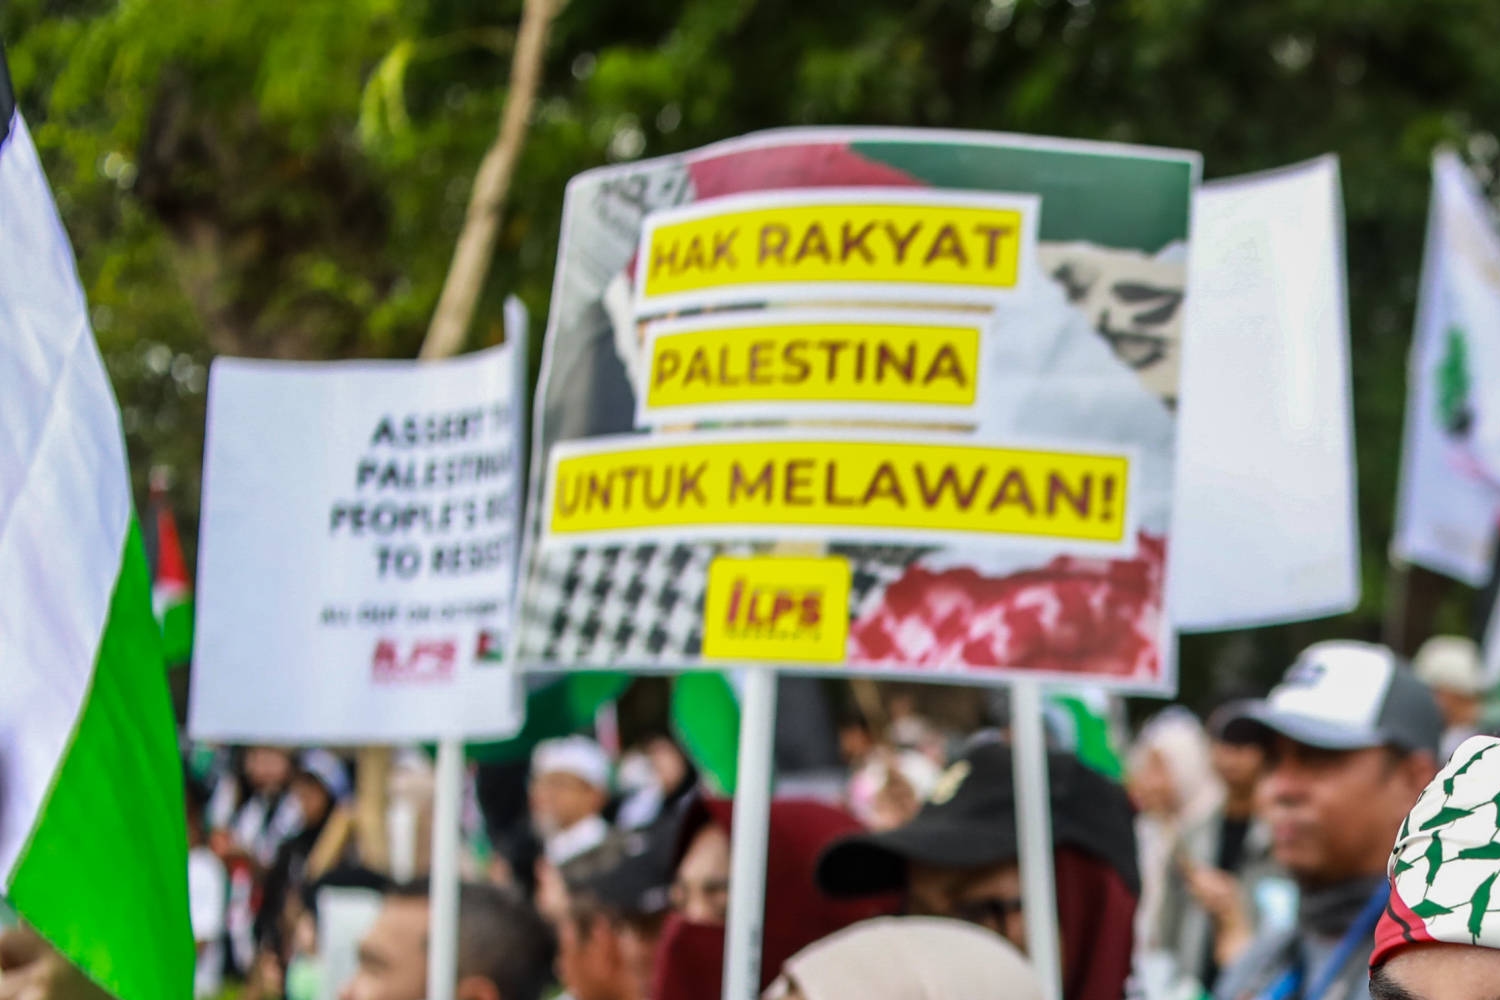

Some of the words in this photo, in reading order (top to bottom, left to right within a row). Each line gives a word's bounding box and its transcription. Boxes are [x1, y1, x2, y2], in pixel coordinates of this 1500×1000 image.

[649, 226, 741, 281] HAK
[754, 219, 1016, 273] RAKYAT
[653, 337, 970, 391] PALESTINA
[355, 449, 514, 490] PALESTIN
[556, 459, 709, 519] UNTUK
[726, 457, 1120, 524] MELAWAN!
[375, 543, 422, 581] TO
[726, 577, 823, 626] ILPS
